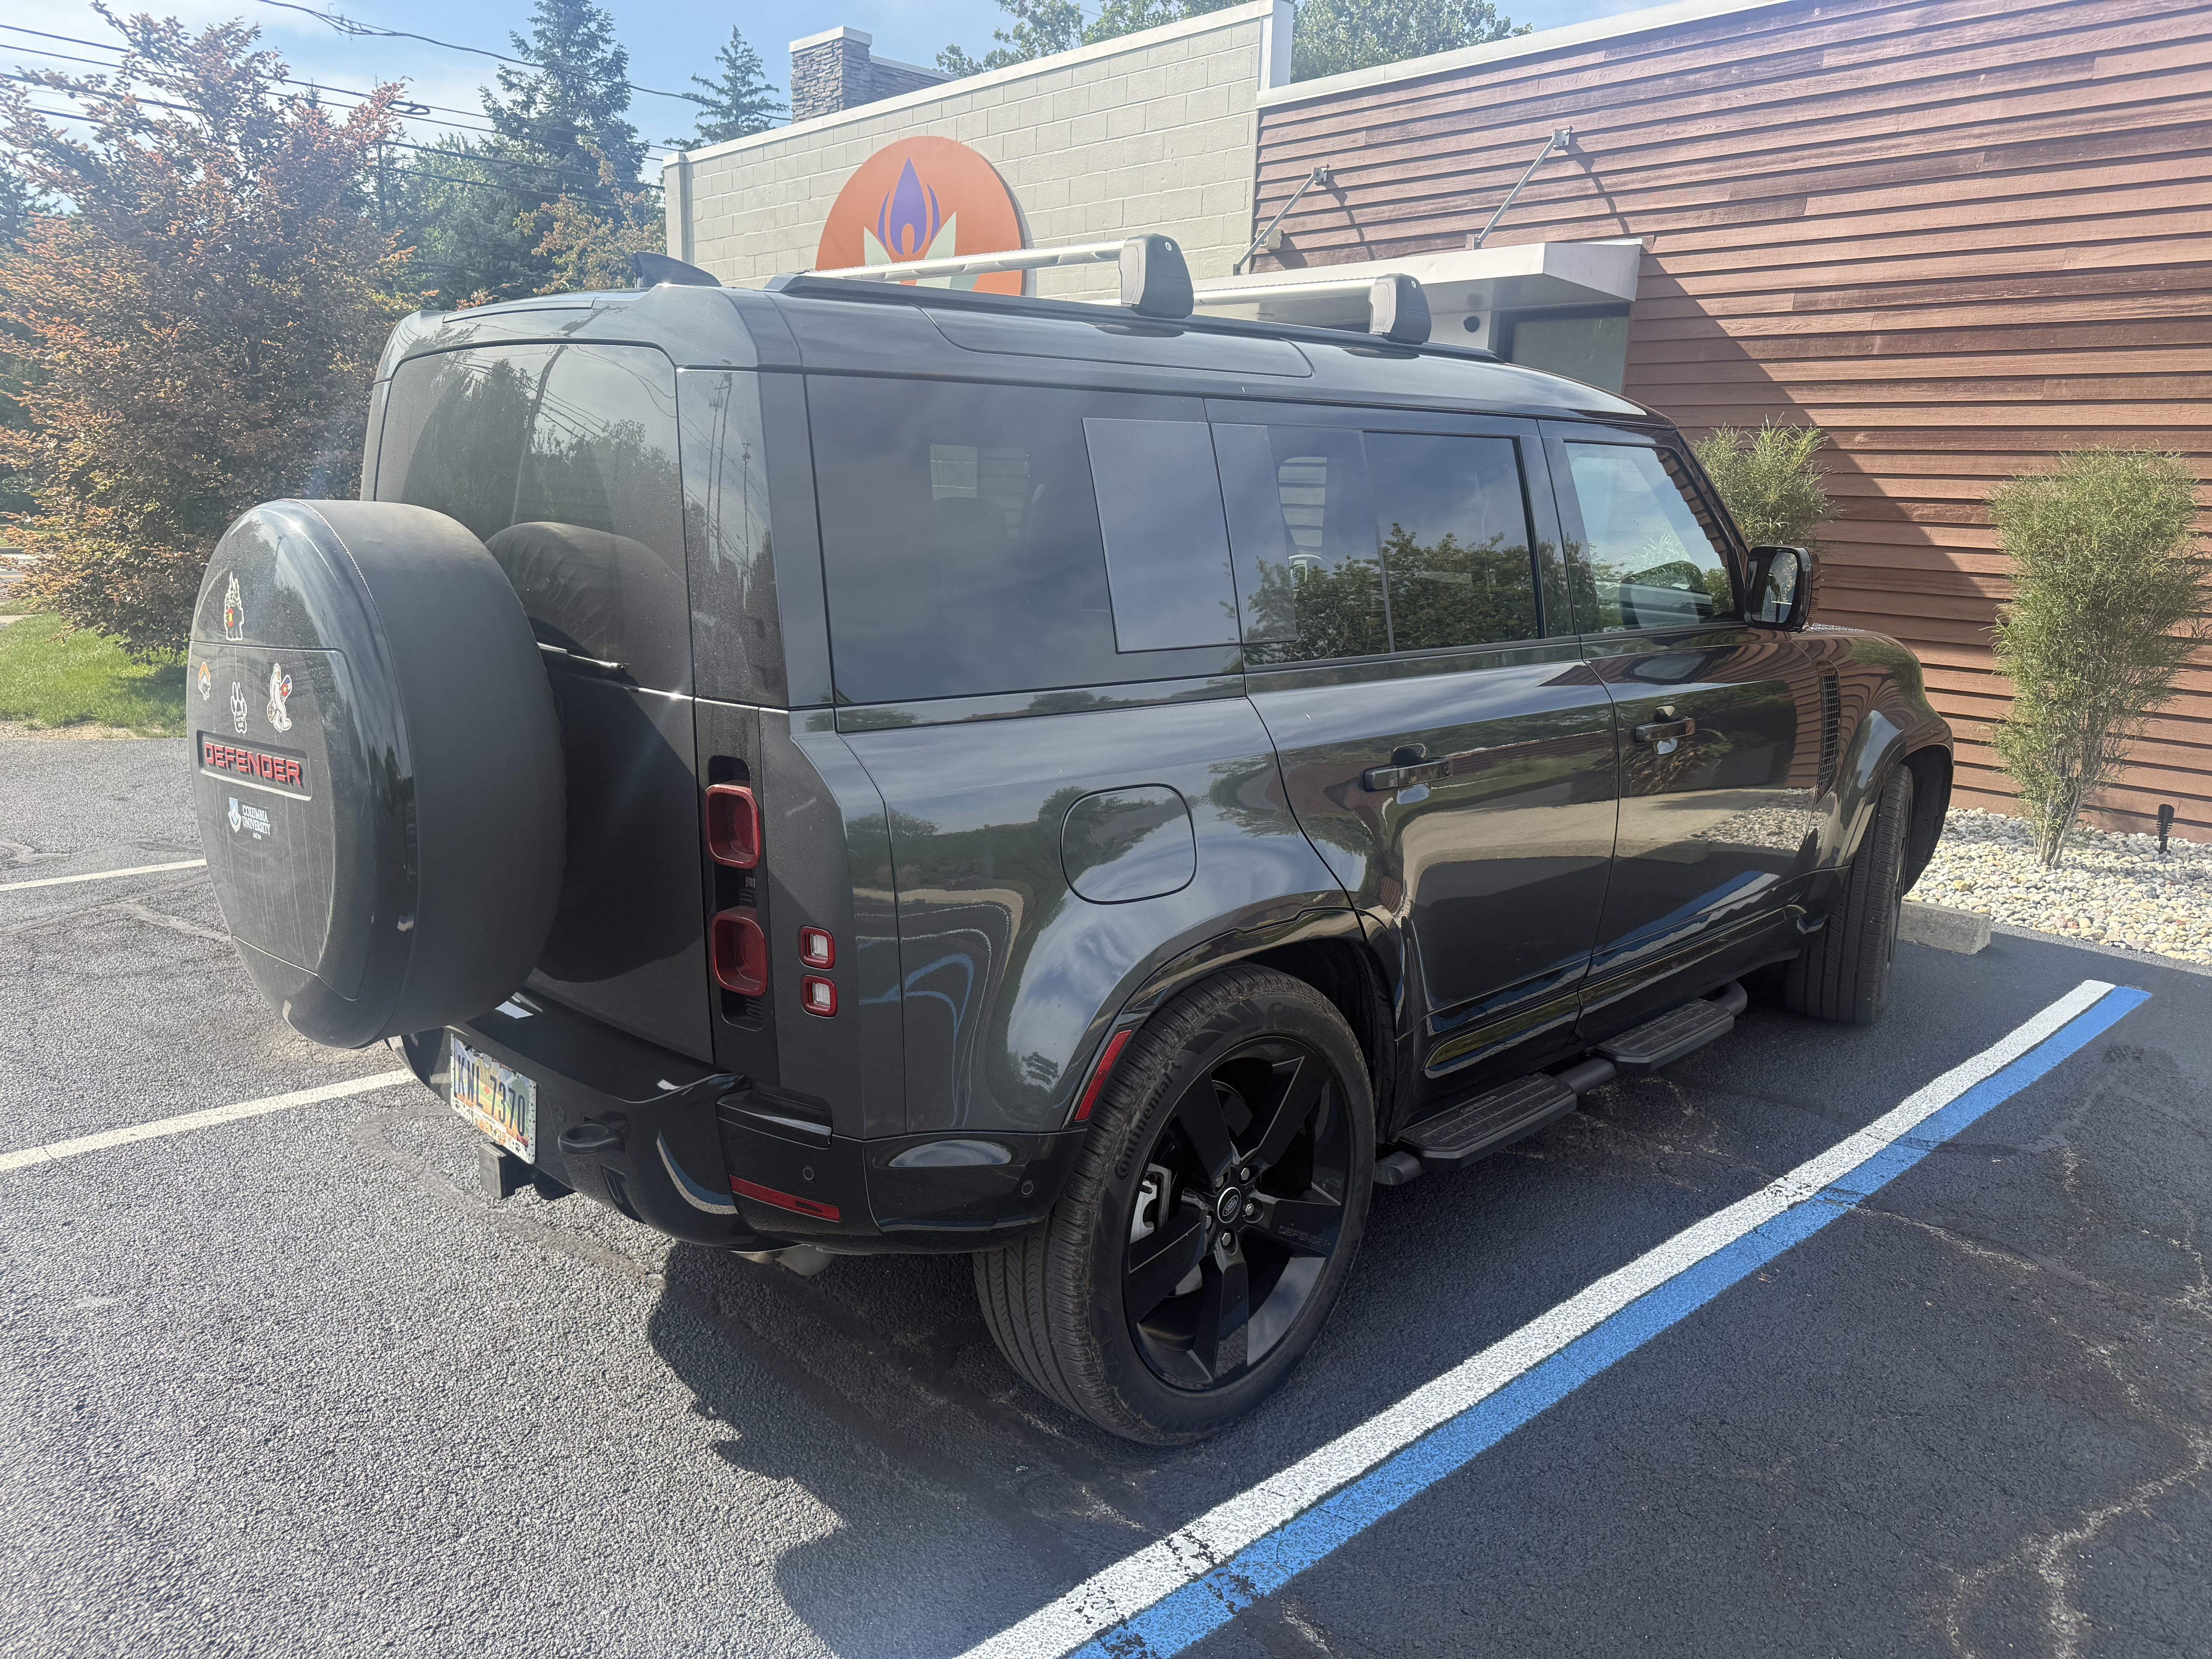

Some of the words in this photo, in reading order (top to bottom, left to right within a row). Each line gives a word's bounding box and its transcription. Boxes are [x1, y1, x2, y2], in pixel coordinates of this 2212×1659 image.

[205, 742, 301, 786] DEFENDER
[242, 805, 269, 823] COLUMBIA
[242, 816, 270, 835] UNIVERSITY
[252, 831, 262, 840] MOM
[458, 1054, 483, 1109] KWL
[489, 1075, 526, 1137] 7370
[1115, 1070, 1173, 1181] Continental
[1278, 1225, 1331, 1248] DEFENDER
